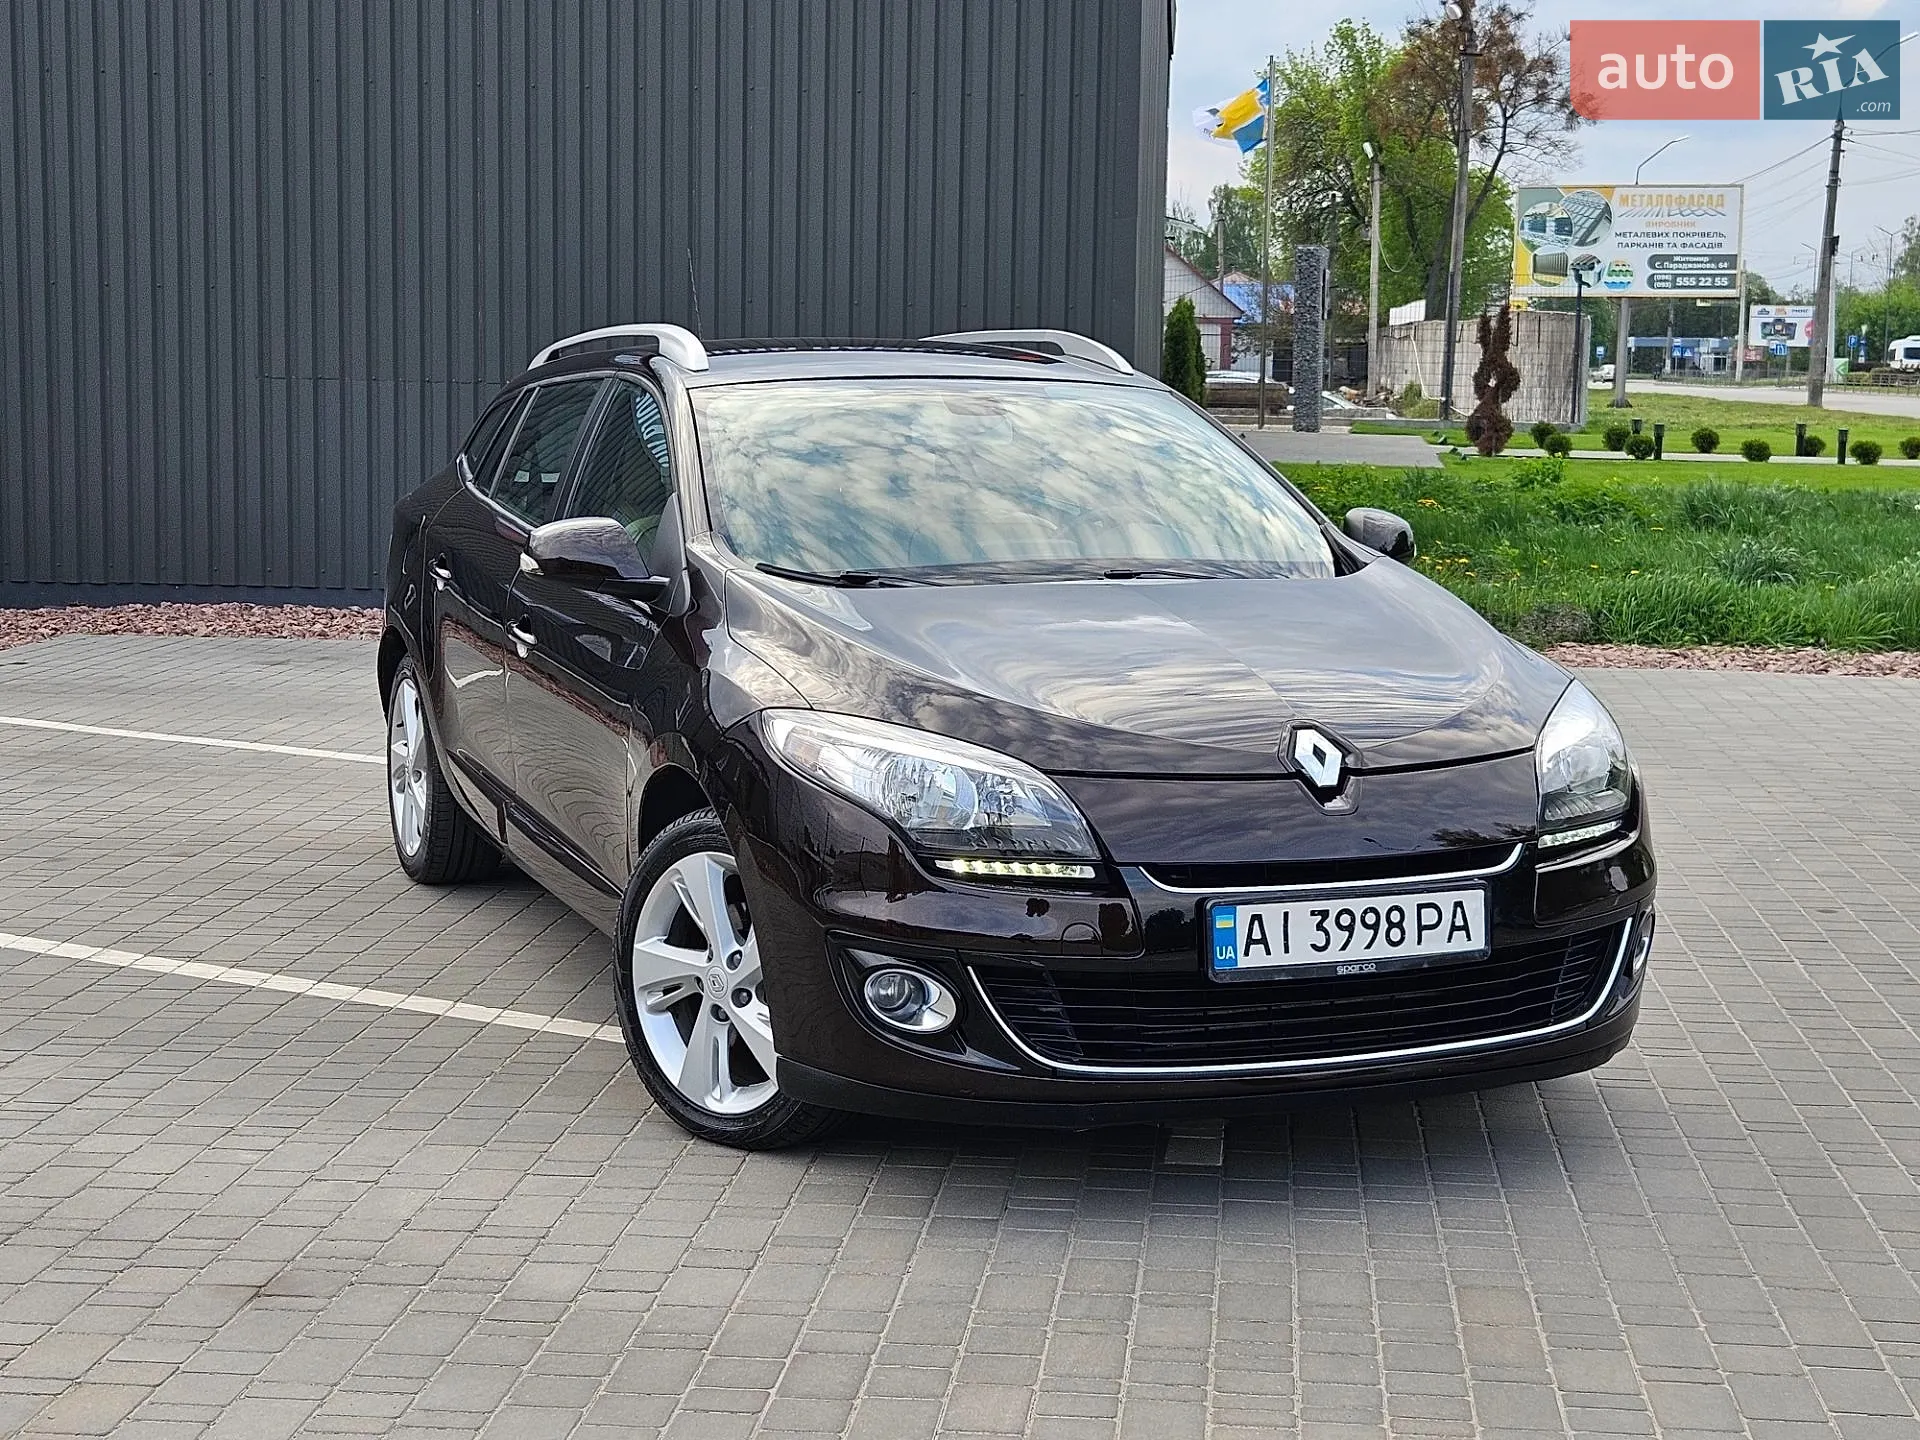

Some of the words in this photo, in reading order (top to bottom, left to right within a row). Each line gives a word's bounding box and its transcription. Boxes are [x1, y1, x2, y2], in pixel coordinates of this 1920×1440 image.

[1618, 194, 1725, 208] МЕТАЛОФАСАД
[1614, 231, 1670, 239] МЕТАЛЕВИХ
[1675, 276, 1697, 286] 555
[1698, 276, 1712, 286] 22
[1713, 276, 1728, 286] 55
[1242, 910, 1290, 957] AI
[1216, 945, 1235, 960] UA
[1336, 963, 1377, 975] sparco
